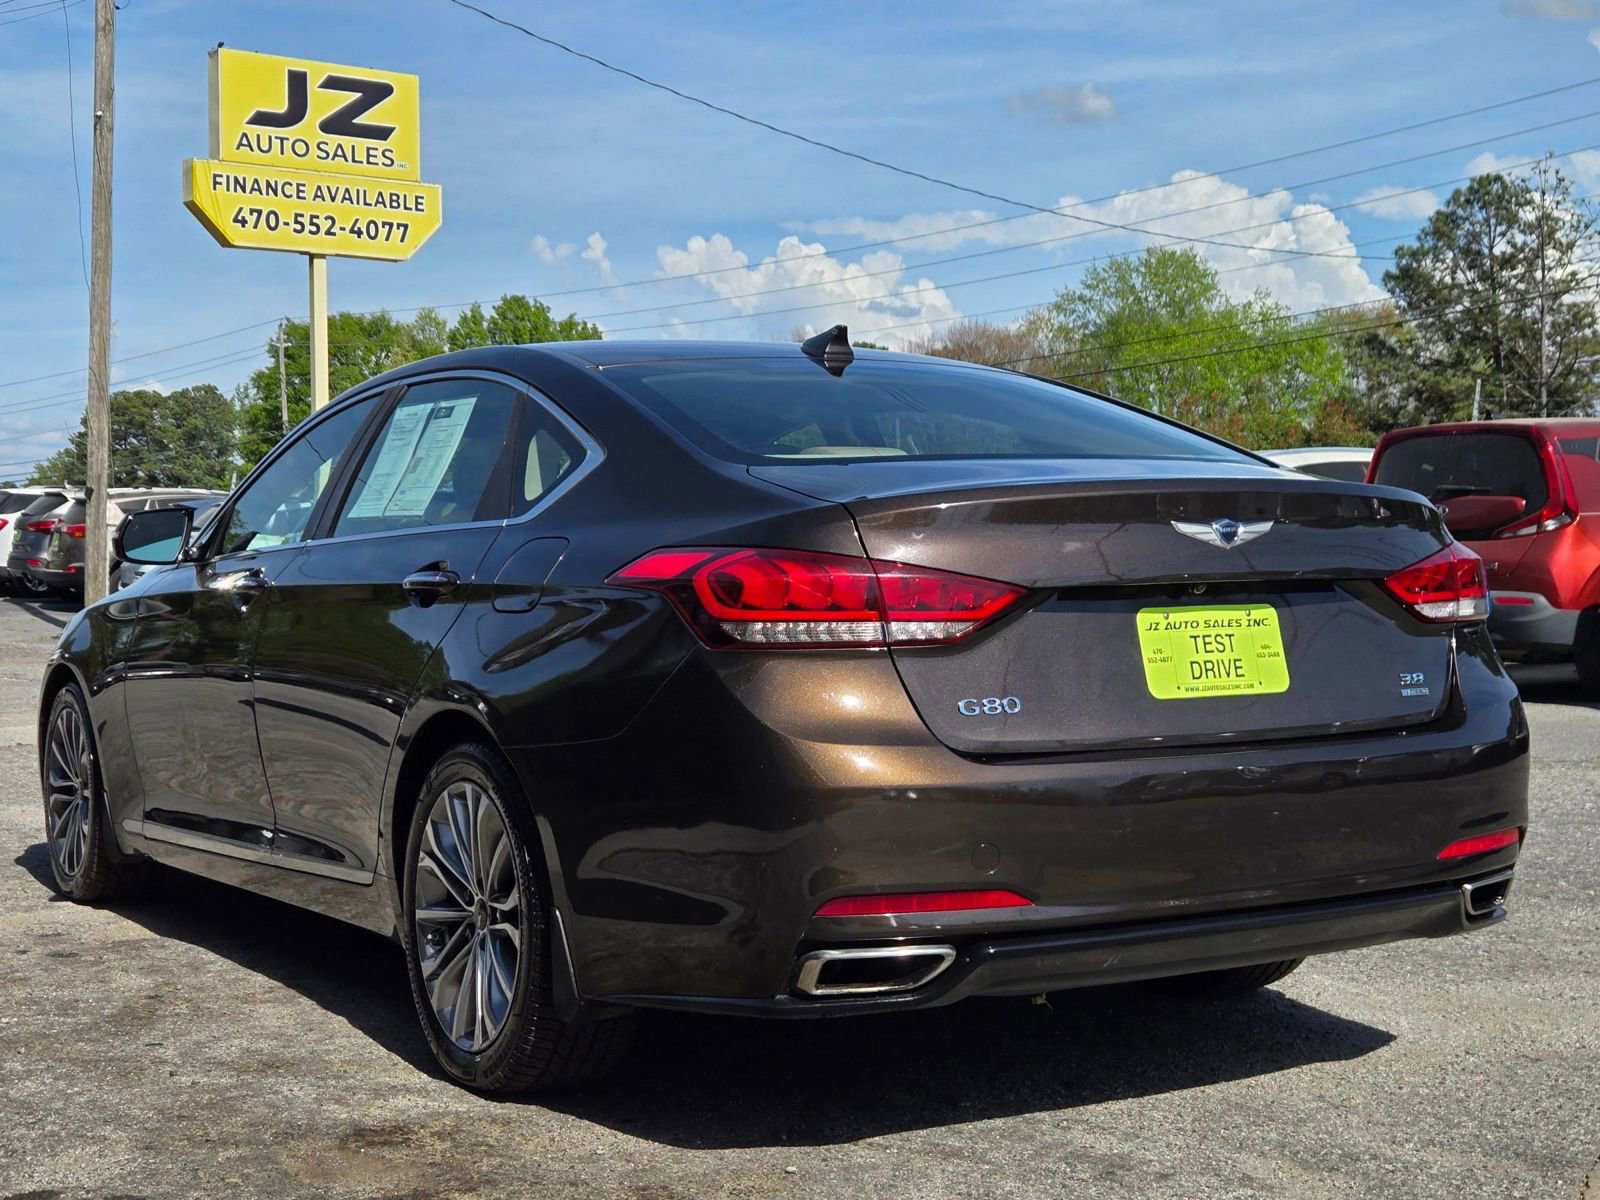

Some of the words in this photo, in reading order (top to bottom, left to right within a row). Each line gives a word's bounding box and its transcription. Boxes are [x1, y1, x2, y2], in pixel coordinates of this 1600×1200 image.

[244, 68, 397, 141] JZ
[235, 131, 310, 158] AUTO
[316, 141, 395, 168] SALES
[212, 173, 307, 200] FINANCE
[312, 185, 425, 212] AVAILABLE
[232, 207, 410, 243] 470-552-4077
[1145, 622, 1160, 631] JZ
[1164, 619, 1199, 631] AUTO
[1203, 618, 1242, 628] SALES
[1245, 617, 1272, 628] INC.
[1189, 633, 1235, 654] TEST
[1190, 658, 1245, 680] DRIVE
[957, 696, 1021, 717] G80
